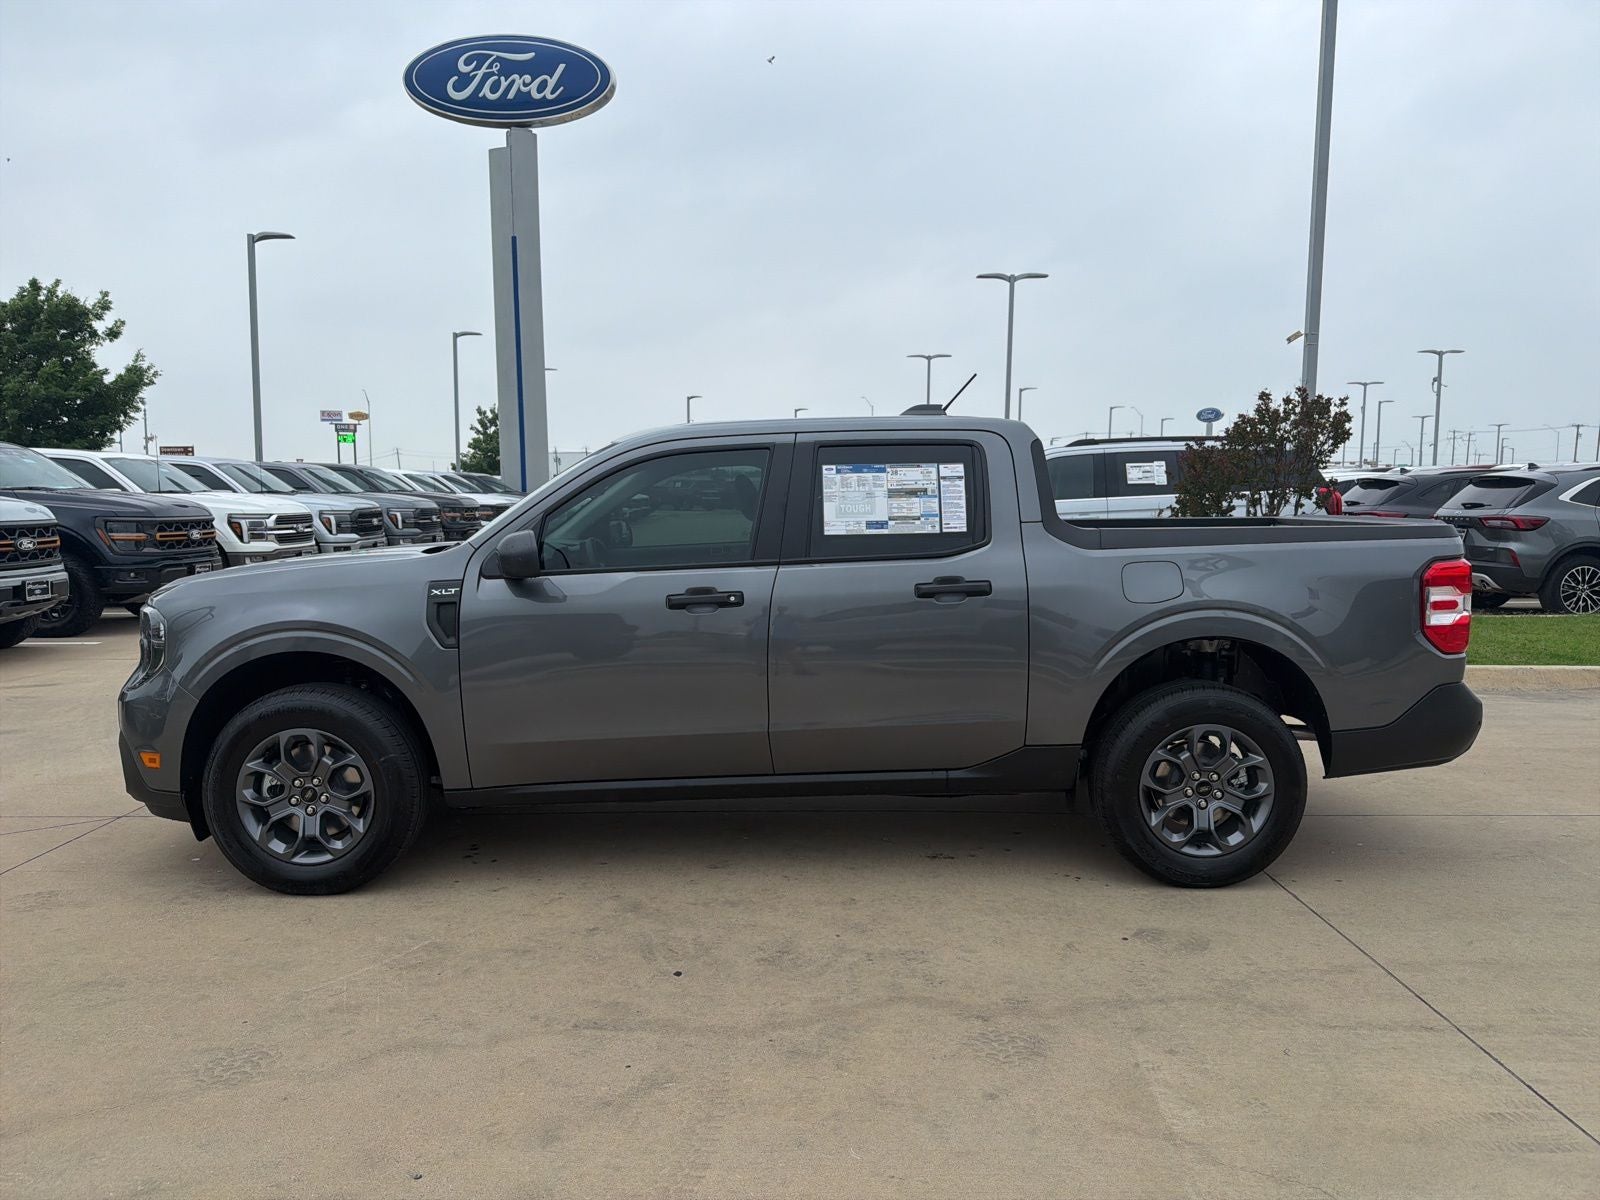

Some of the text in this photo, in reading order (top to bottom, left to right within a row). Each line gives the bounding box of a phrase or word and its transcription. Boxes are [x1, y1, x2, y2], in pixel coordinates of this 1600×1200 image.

[446, 50, 566, 100] Ford
[840, 504, 871, 512] TOUGH
[21, 539, 34, 549] Ford
[430, 588, 460, 596] XLT
